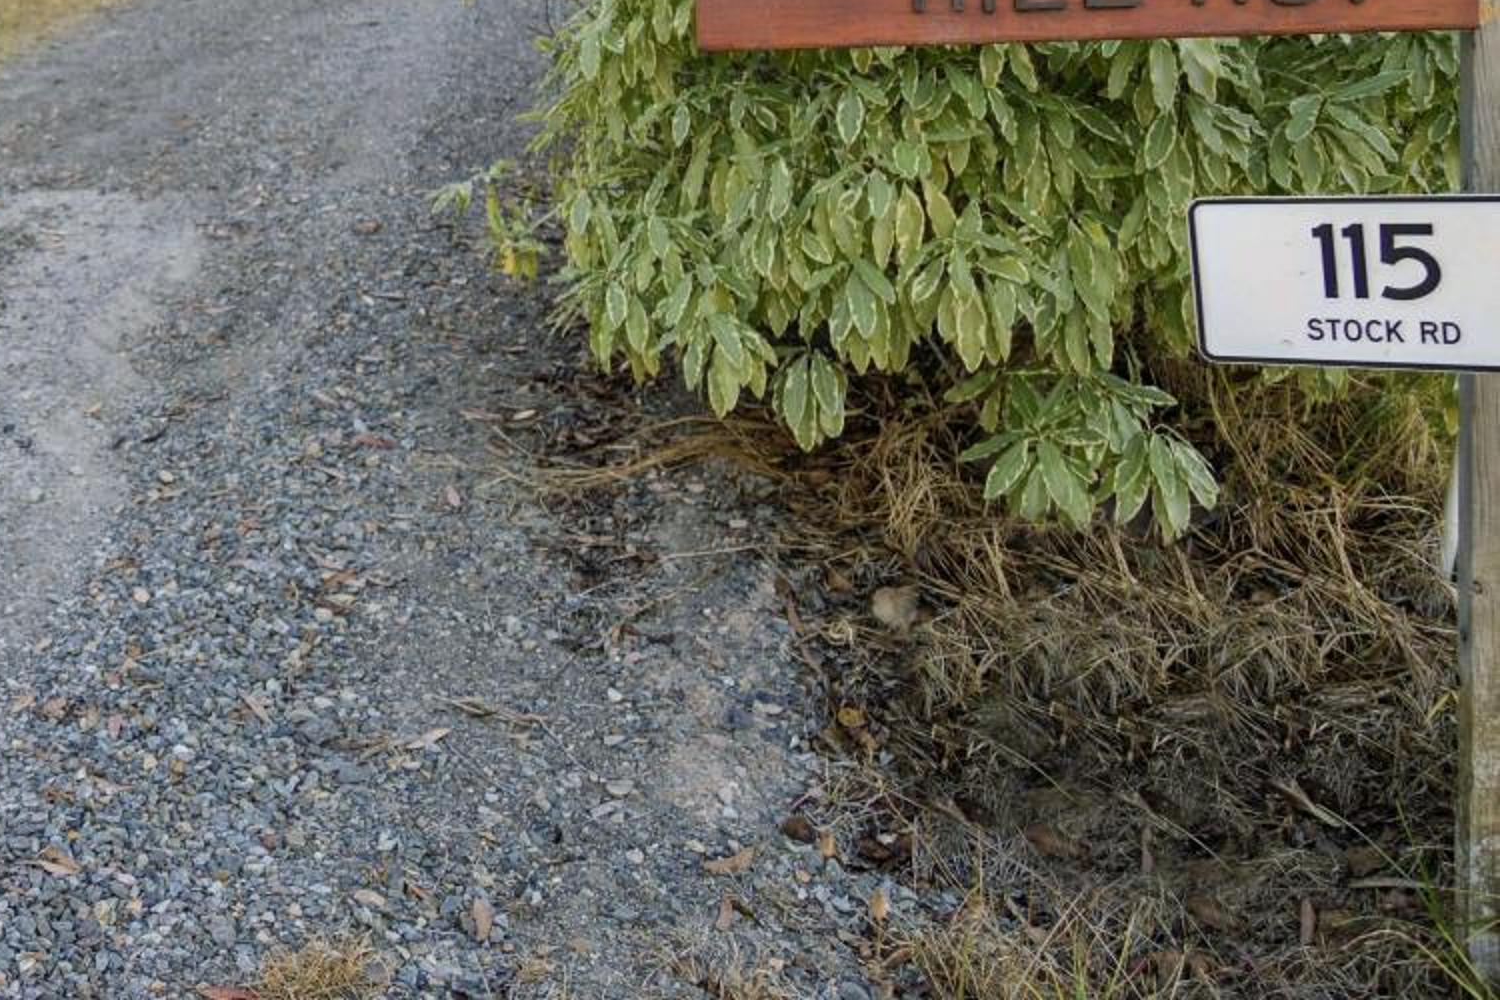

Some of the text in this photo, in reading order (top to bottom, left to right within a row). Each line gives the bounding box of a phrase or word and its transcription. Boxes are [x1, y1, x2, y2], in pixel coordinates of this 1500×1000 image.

[1311, 223, 1442, 300] 115
[1307, 318, 1461, 344] STOCK RD
